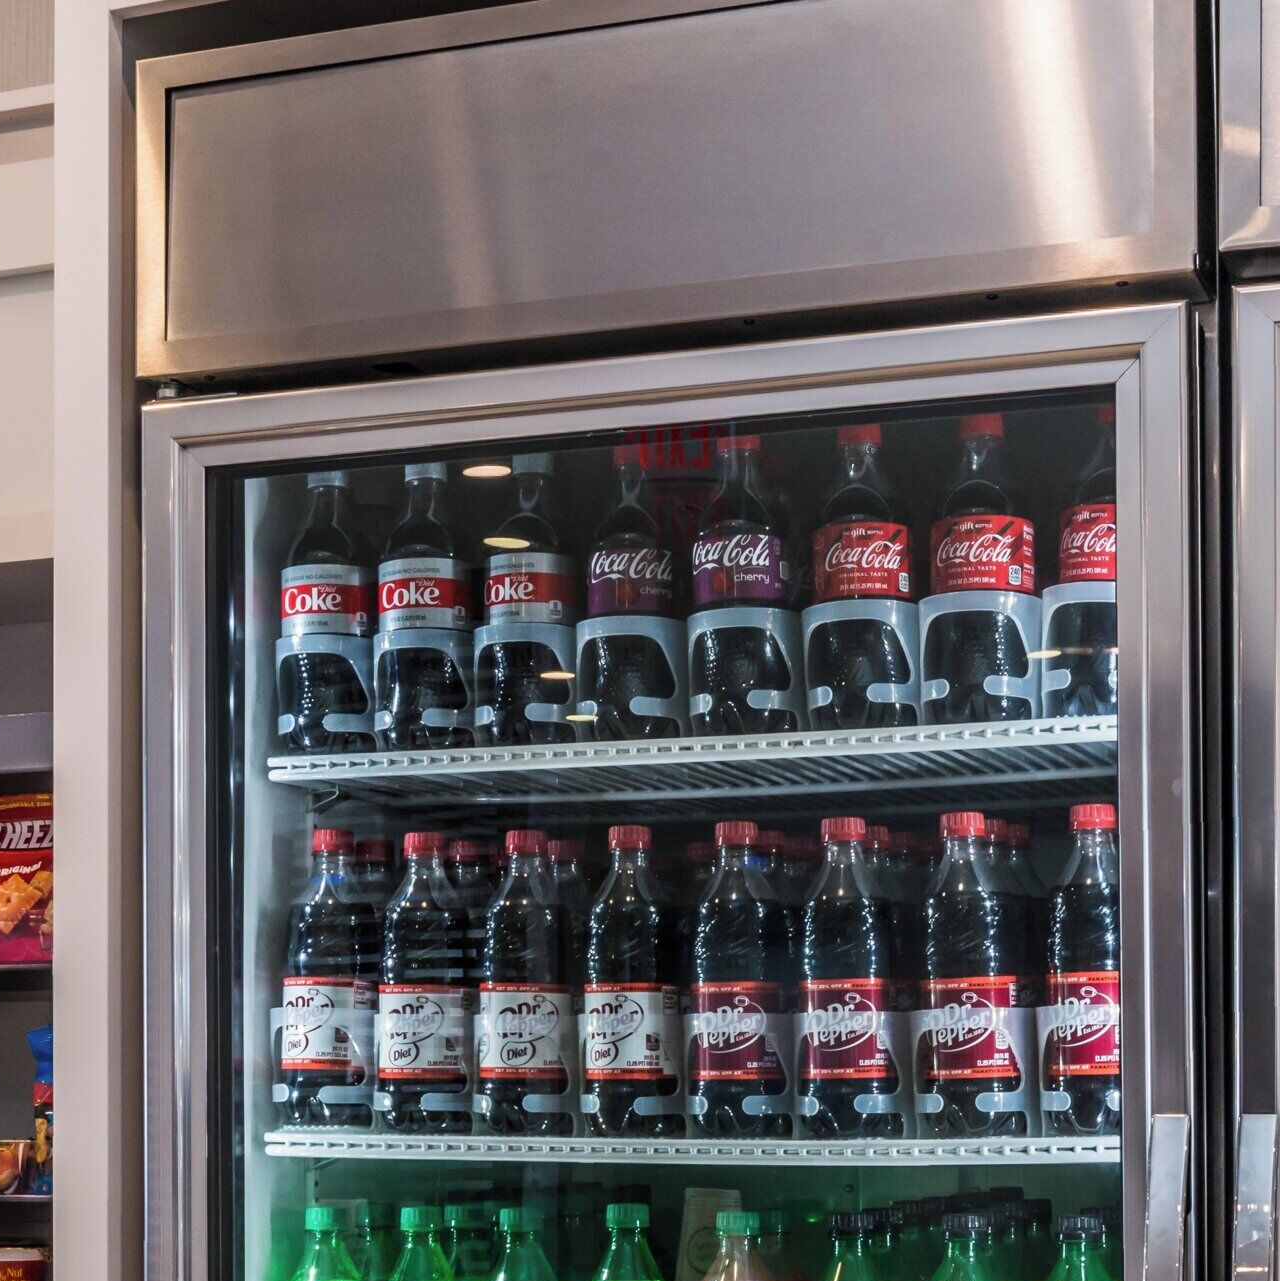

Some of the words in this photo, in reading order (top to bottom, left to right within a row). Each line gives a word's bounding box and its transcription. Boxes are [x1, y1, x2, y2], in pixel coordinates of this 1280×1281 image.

[693, 534, 770, 575] Coca-Cola
[825, 541, 904, 572] Coca-Cola
[937, 534, 1015, 567] Coca-Cola
[320, 585, 337, 593] Diet
[417, 578, 435, 586] Diet
[734, 572, 770, 585] cherry
[285, 587, 342, 614] Coke
[382, 581, 440, 609] Coke
[927, 1011, 991, 1047] Pepper
[393, 1047, 412, 1062] Diet
[594, 1048, 611, 1062] Diet
[7, 1268, 23, 1278] Nut
